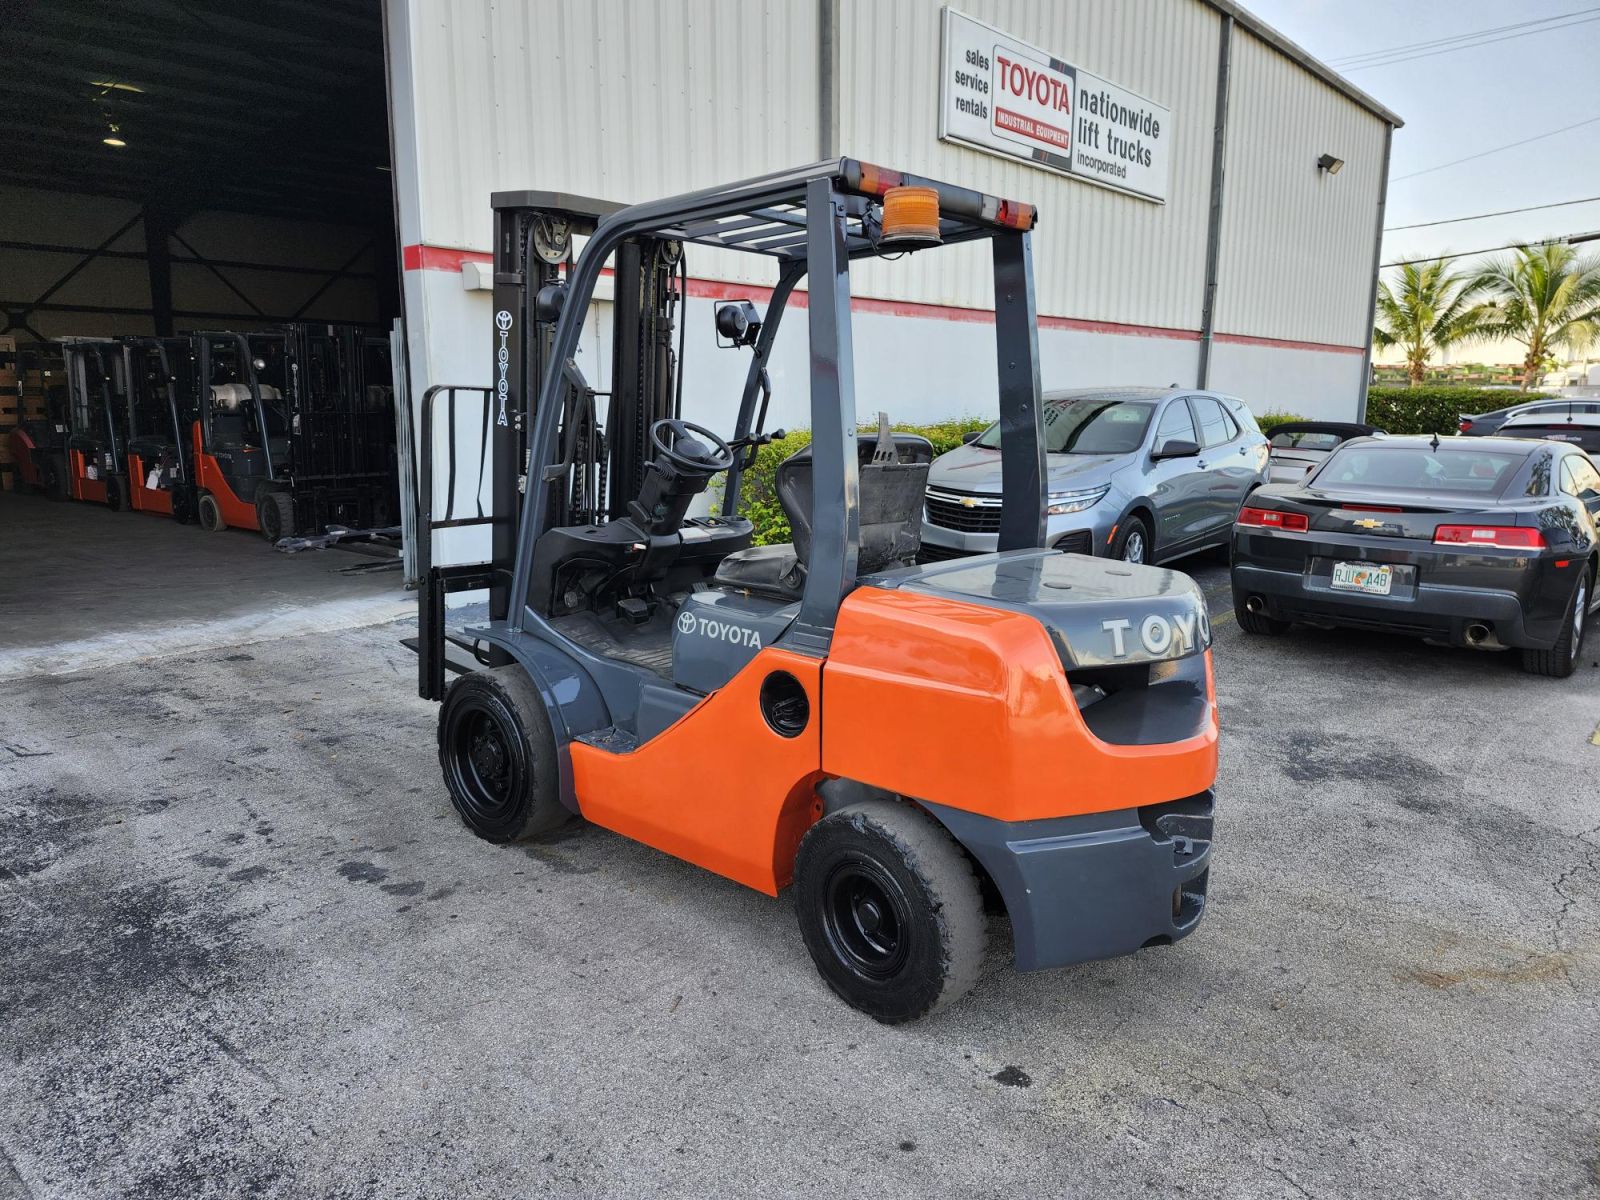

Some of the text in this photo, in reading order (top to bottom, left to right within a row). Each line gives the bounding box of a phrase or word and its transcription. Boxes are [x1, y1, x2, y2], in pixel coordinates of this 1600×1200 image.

[966, 49, 989, 71] sales
[955, 70, 989, 94] service
[997, 56, 1070, 115] TOYOTA
[956, 96, 988, 119] rentals
[1080, 88, 1160, 139] nationwide
[997, 111, 1069, 145] INDUSTRIAL EQUIPMENT
[1078, 117, 1152, 168] lift trucks
[1077, 149, 1127, 179] incorporated
[498, 330, 509, 426] TOYOTA
[699, 618, 762, 650] TOYOTA
